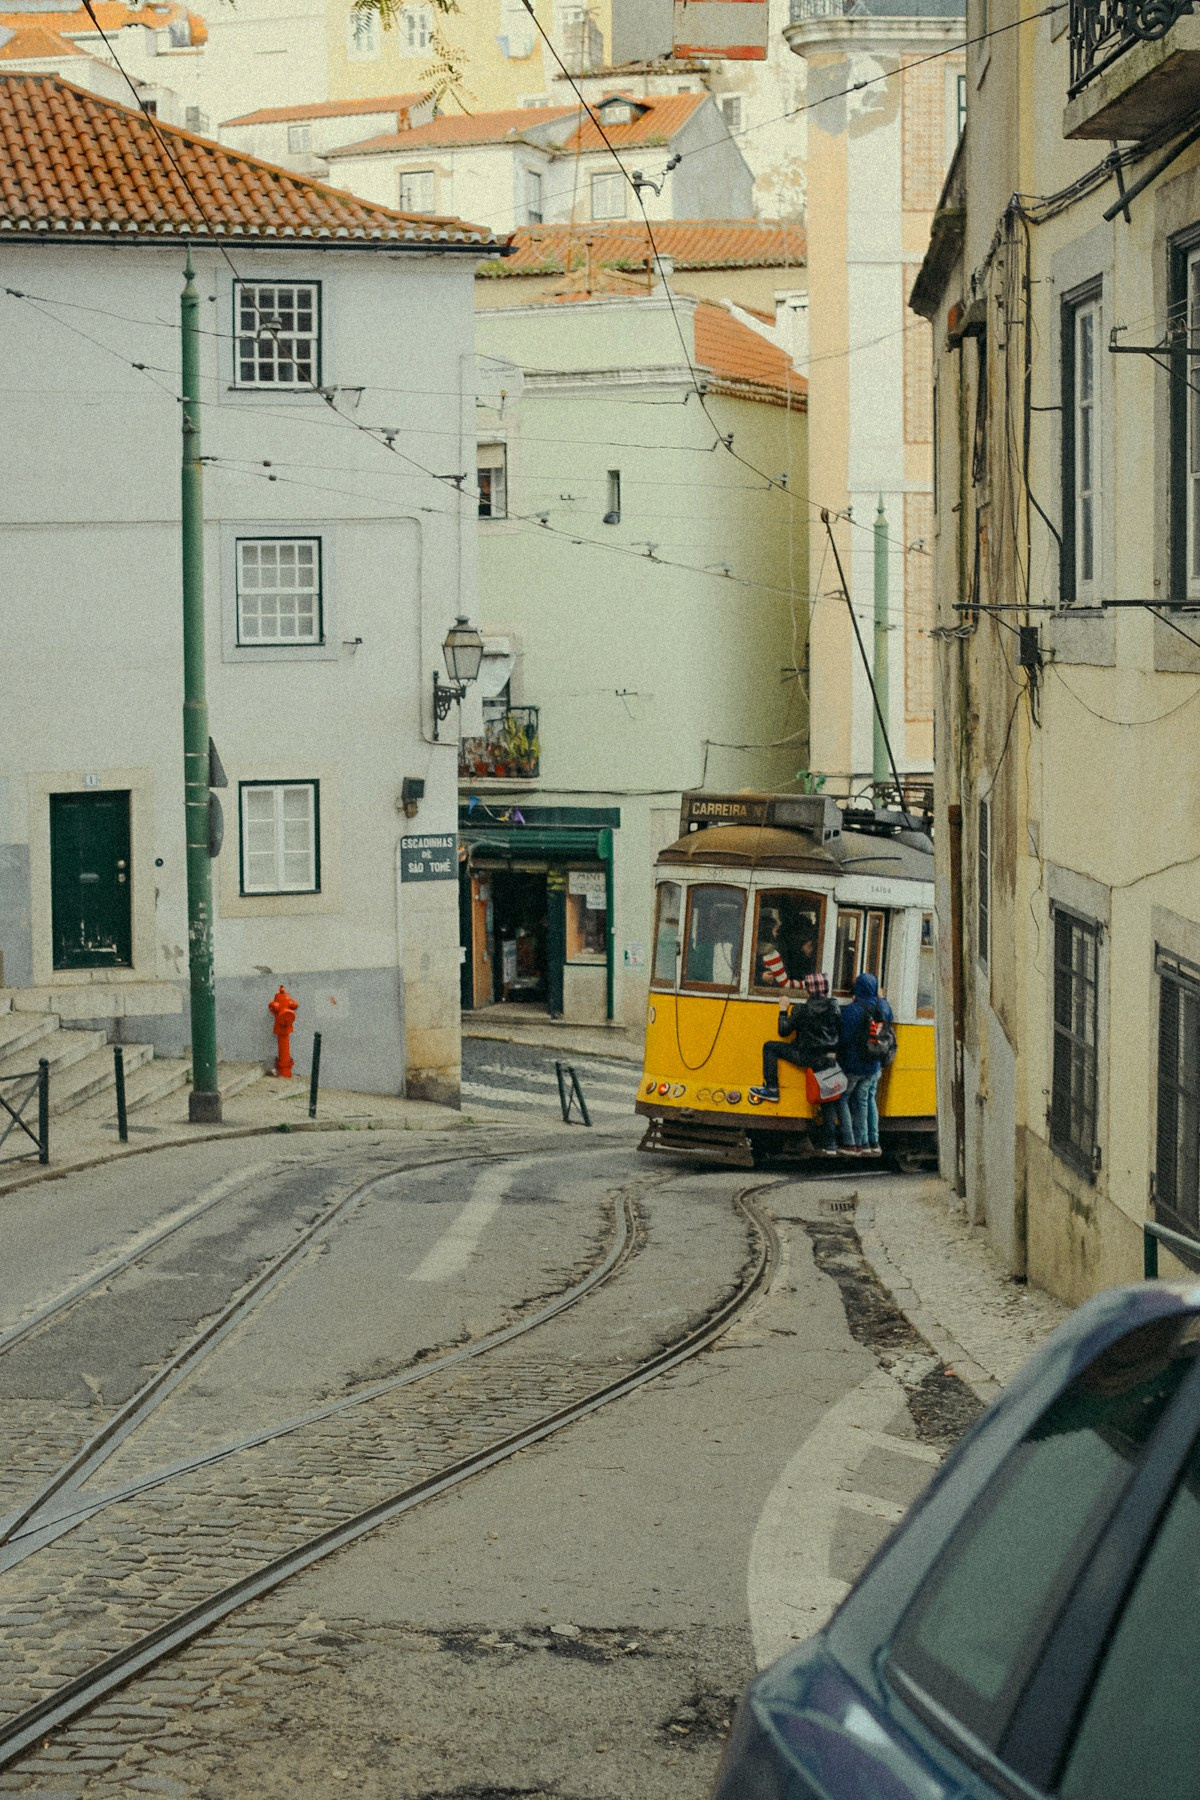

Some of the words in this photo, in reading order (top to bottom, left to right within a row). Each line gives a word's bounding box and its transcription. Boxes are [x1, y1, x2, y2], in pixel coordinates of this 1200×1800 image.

[692, 802, 747, 817] CARREIRA
[402, 837, 453, 849] ESCADINHAS
[421, 850, 432, 859] DE
[408, 860, 424, 873] SÃO
[429, 858, 451, 873] TOMÉ
